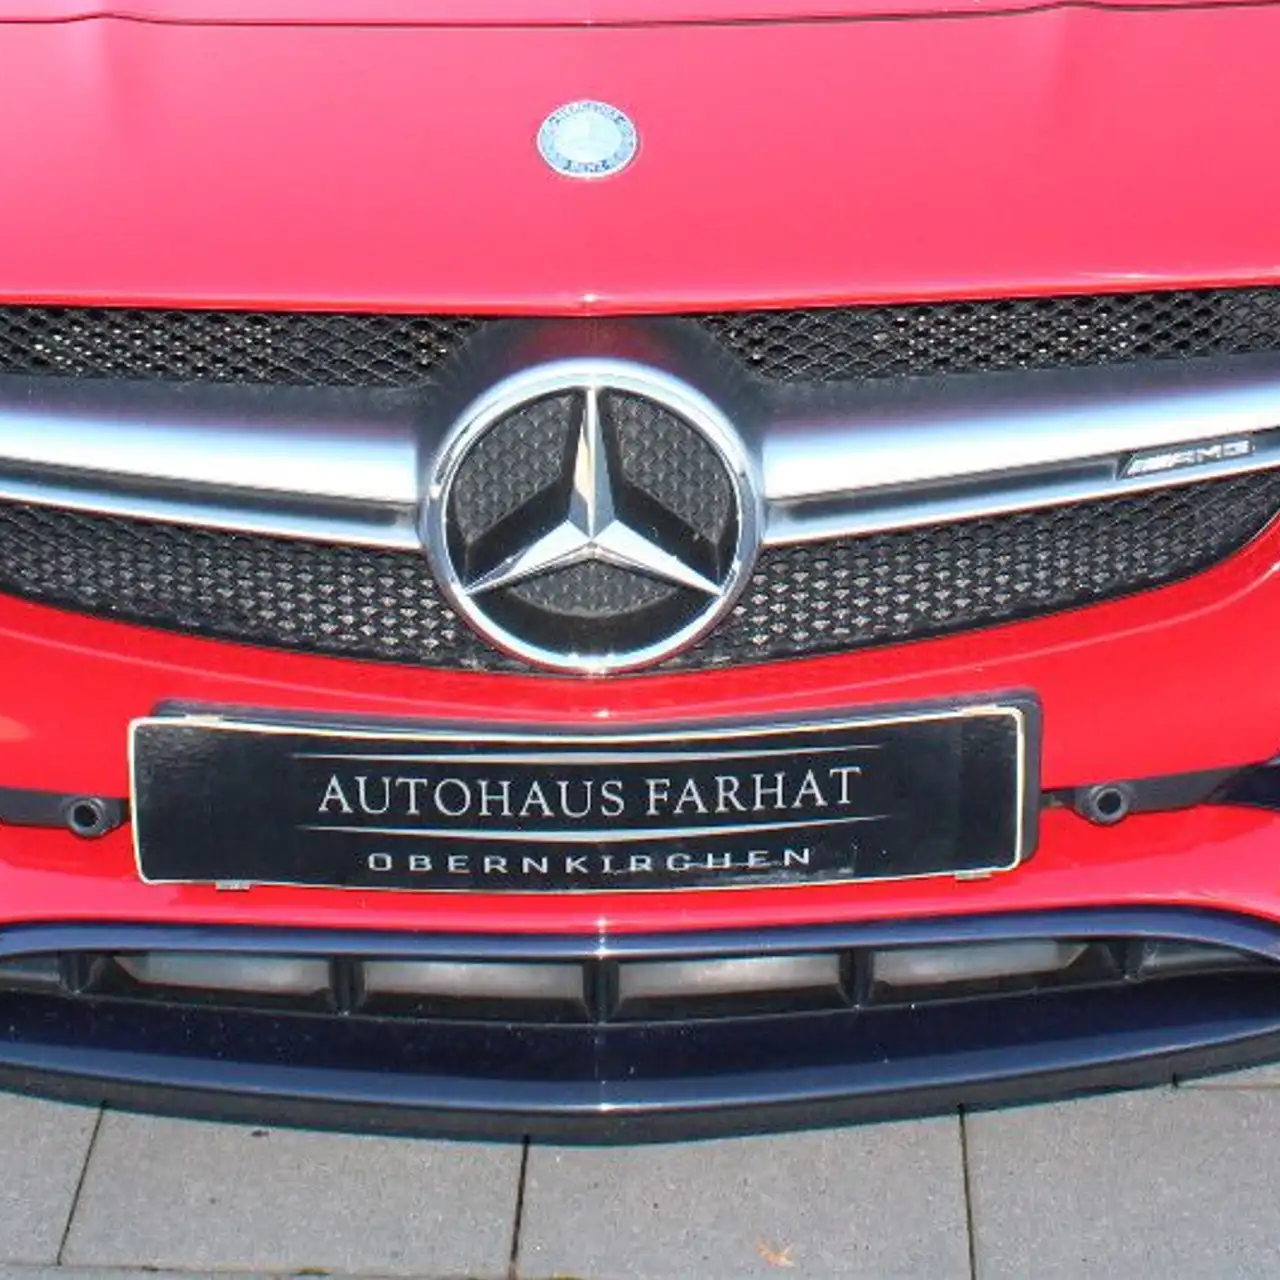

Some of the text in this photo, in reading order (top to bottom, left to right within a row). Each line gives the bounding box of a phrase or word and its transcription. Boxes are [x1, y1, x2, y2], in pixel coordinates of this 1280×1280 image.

[318, 766, 860, 817] AUTOHAUS FARHAT
[368, 847, 811, 873] OBERNKIRCHEN
